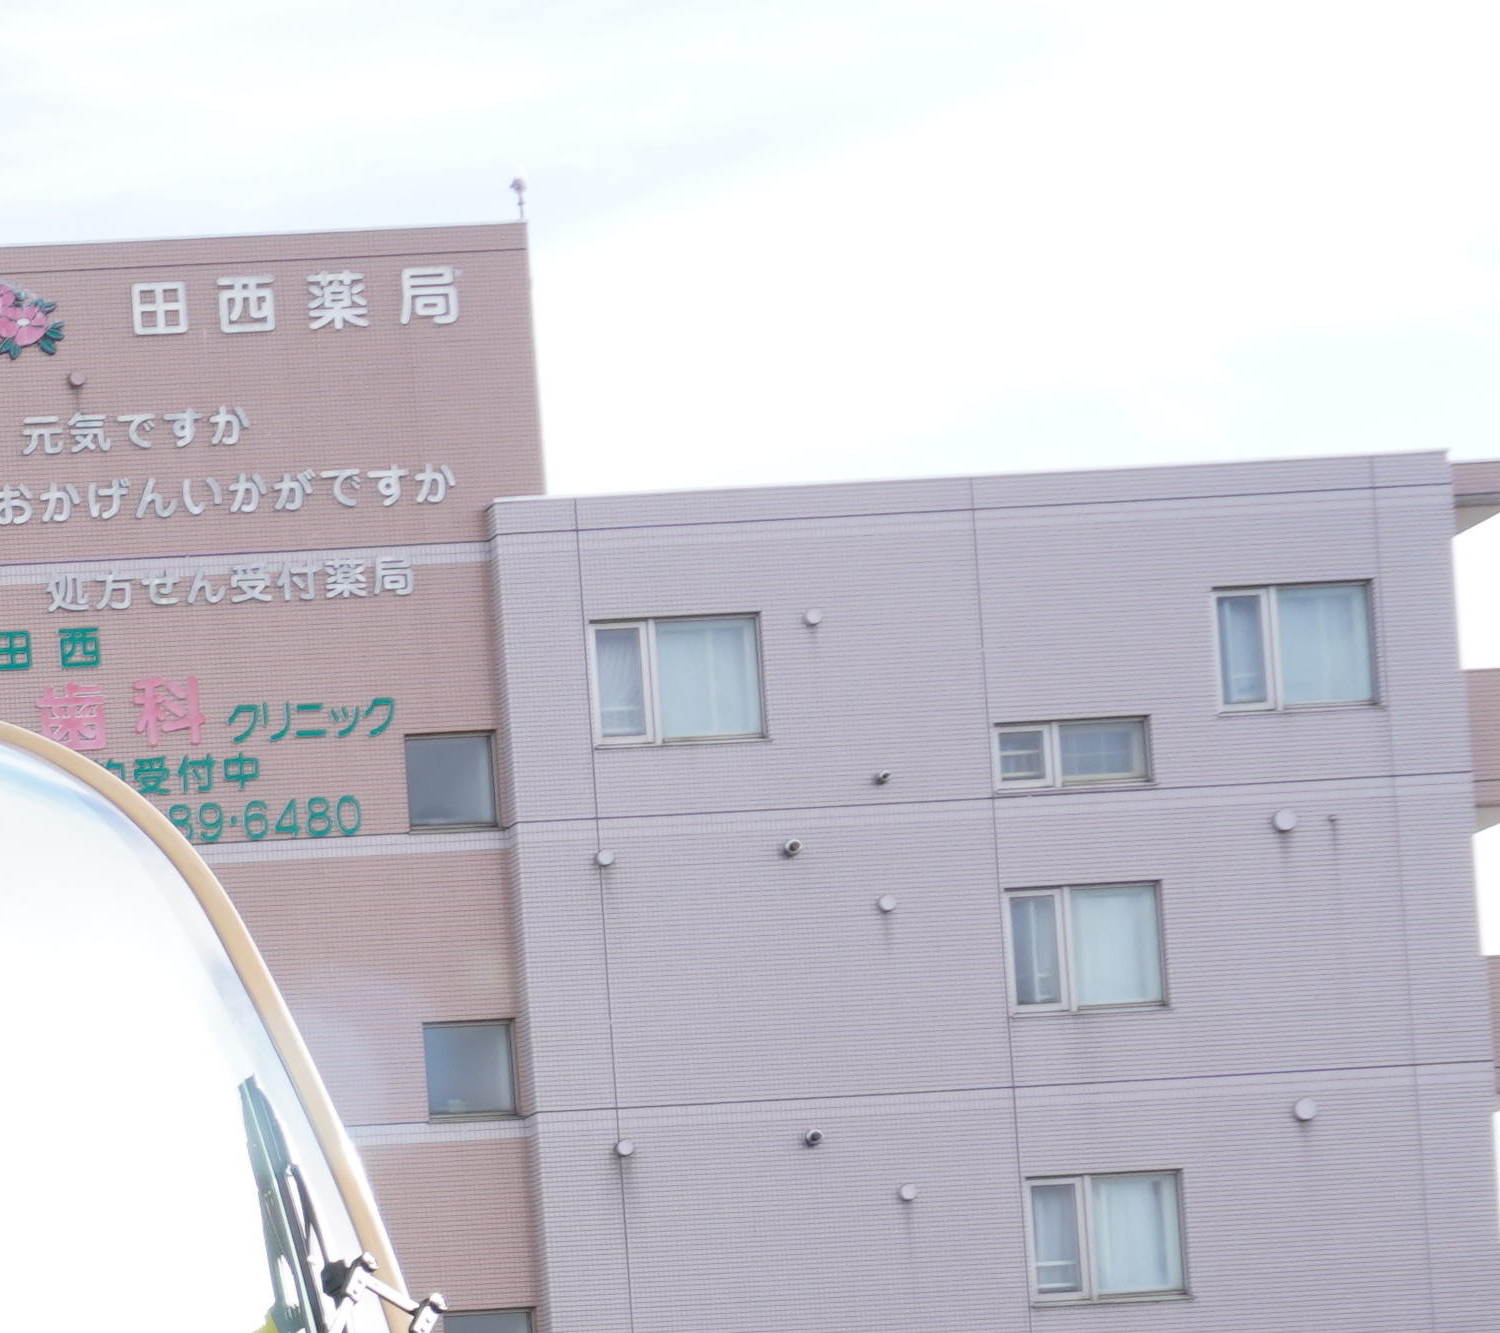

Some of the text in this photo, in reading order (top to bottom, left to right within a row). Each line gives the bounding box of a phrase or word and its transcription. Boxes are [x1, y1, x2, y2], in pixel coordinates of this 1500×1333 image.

[131, 266, 460, 336] 田西薬局
[21, 405, 250, 456] 元気ですか
[46, 555, 415, 613] 処方せん受付薬局
[36, 676, 396, 750] 歯科 クリニック
